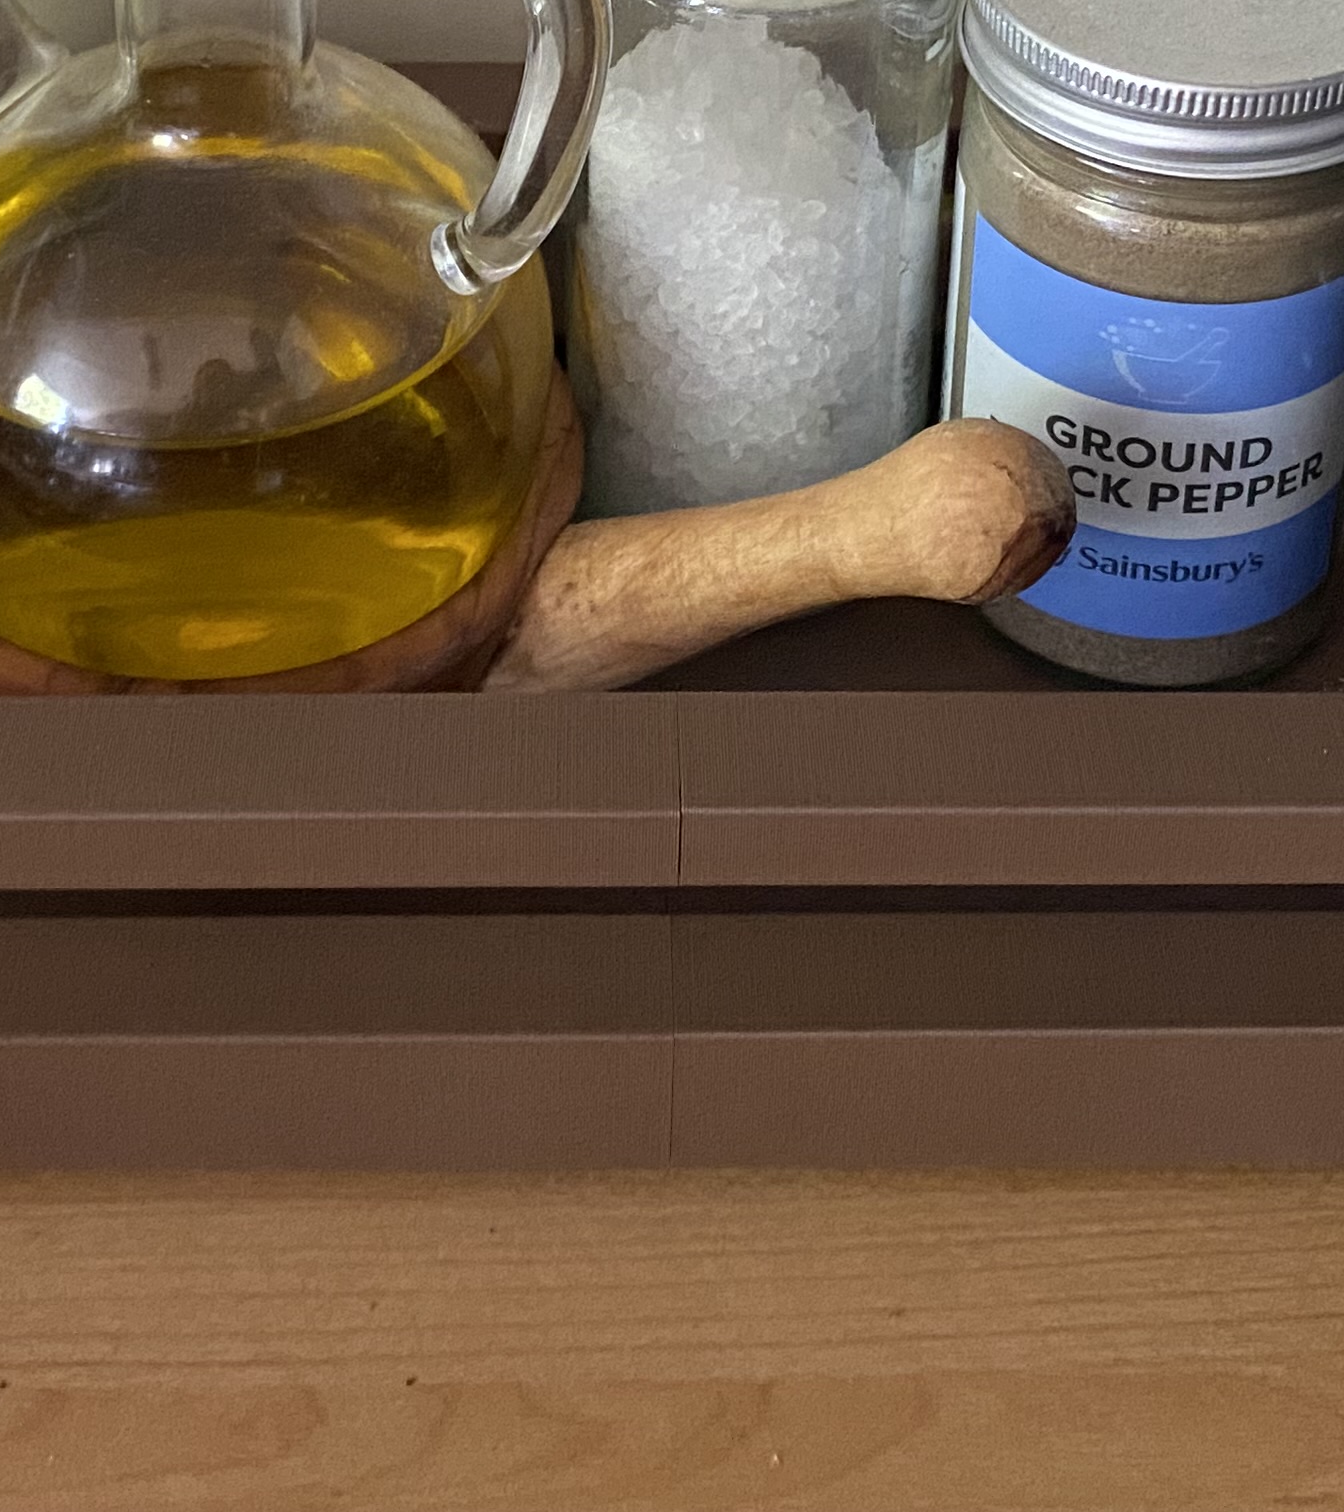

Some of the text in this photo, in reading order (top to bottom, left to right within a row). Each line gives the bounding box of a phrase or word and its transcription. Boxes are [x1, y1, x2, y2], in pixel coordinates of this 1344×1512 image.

[1045, 414, 1273, 473] GROUND
[1147, 451, 1324, 514] PEPPER
[1077, 546, 1264, 584] Sainsbury's
